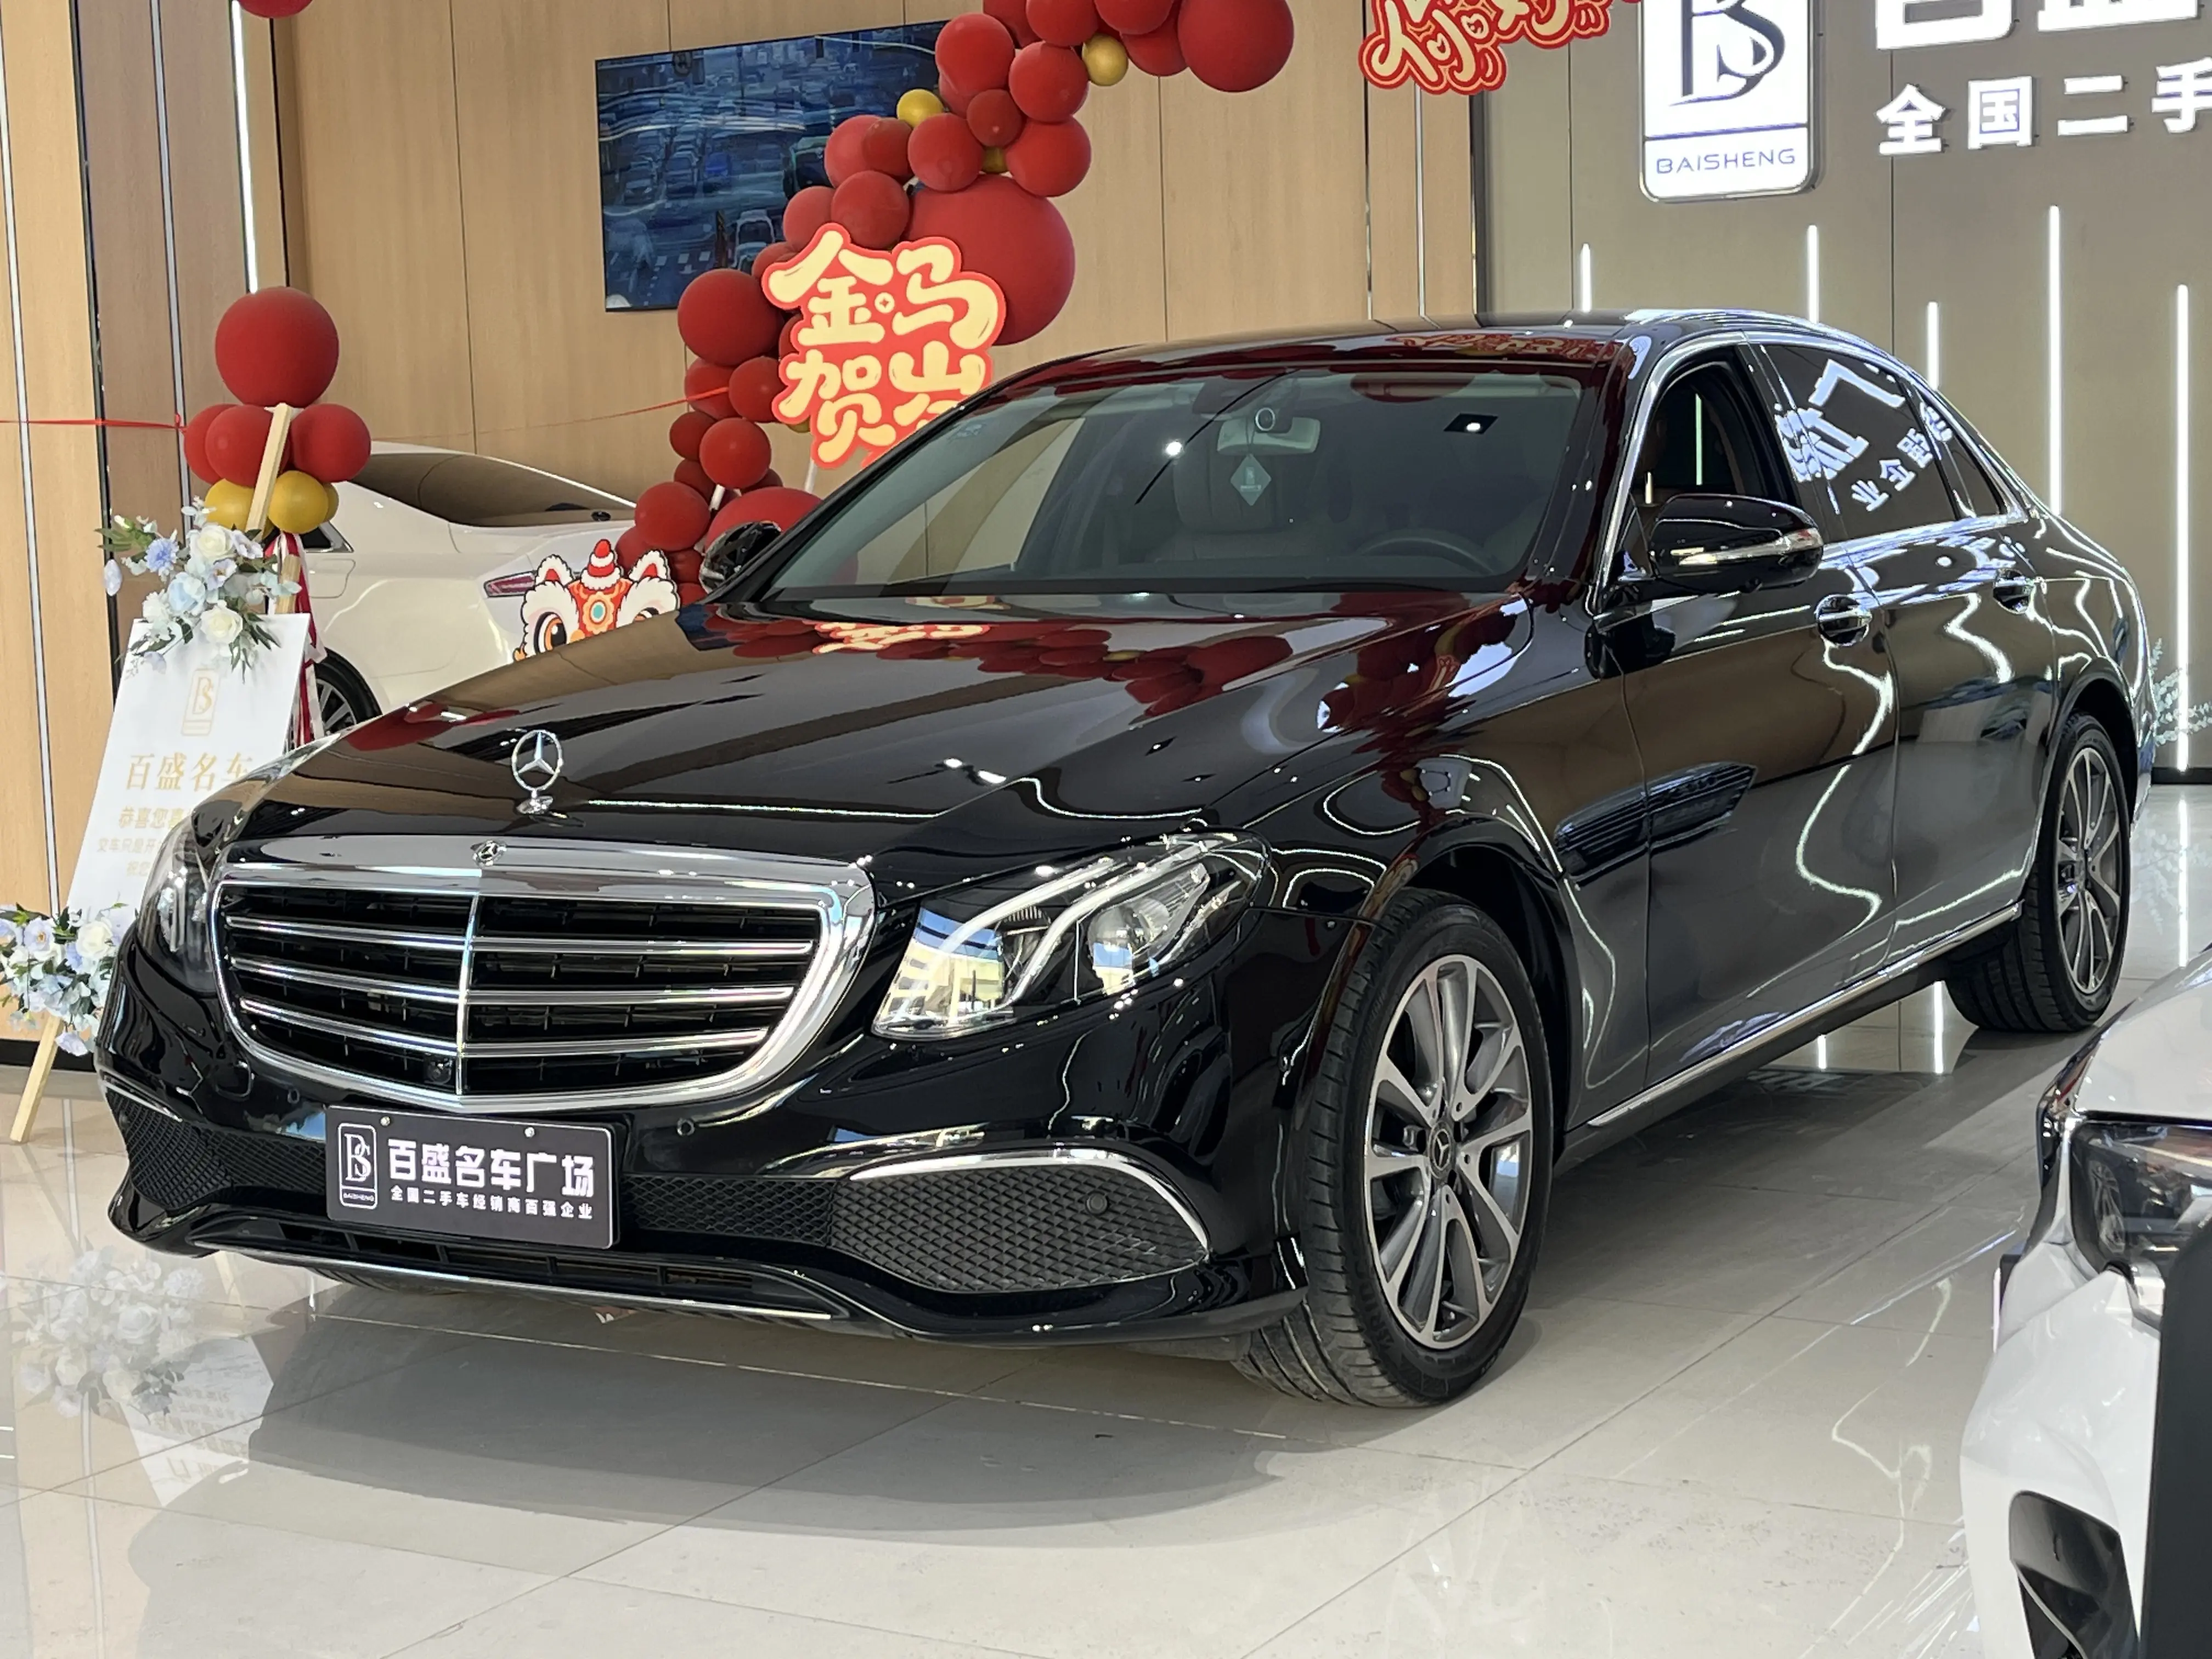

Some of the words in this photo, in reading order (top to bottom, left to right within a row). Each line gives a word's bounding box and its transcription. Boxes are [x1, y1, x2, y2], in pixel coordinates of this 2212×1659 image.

[1875, 57, 2212, 155] 全国二手
[1656, 148, 1796, 174] BAISHENG
[769, 230, 998, 349] 金马
[126, 752, 252, 791] 百盛名车
[119, 806, 192, 830] 恭喜您喜
[387, 1138, 595, 1198] 百盛名车广场
[390, 1184, 593, 1220] 全国二手车经销商百强企业
